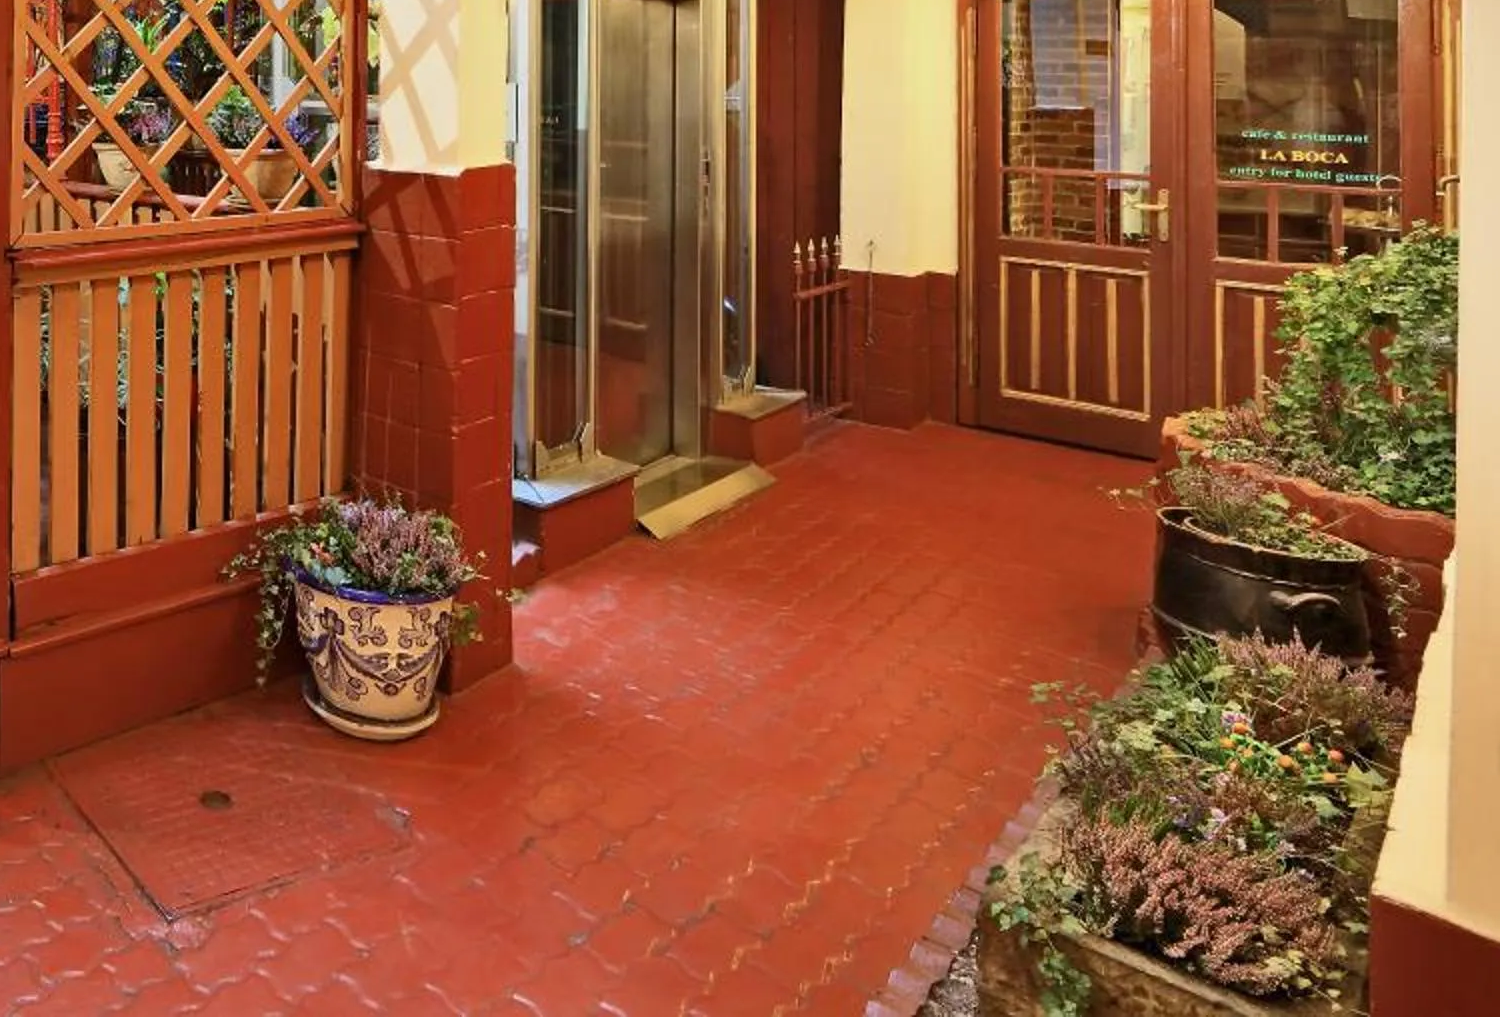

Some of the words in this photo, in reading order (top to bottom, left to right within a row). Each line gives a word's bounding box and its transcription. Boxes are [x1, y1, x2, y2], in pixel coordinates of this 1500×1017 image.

[1273, 130, 1287, 140] &
[1291, 131, 1370, 143] restaurant
[1260, 149, 1287, 161] LA
[1291, 150, 1349, 164] BOCA
[1229, 166, 1265, 178] entry
[1270, 167, 1294, 177] for
[1295, 168, 1331, 180] hotel
